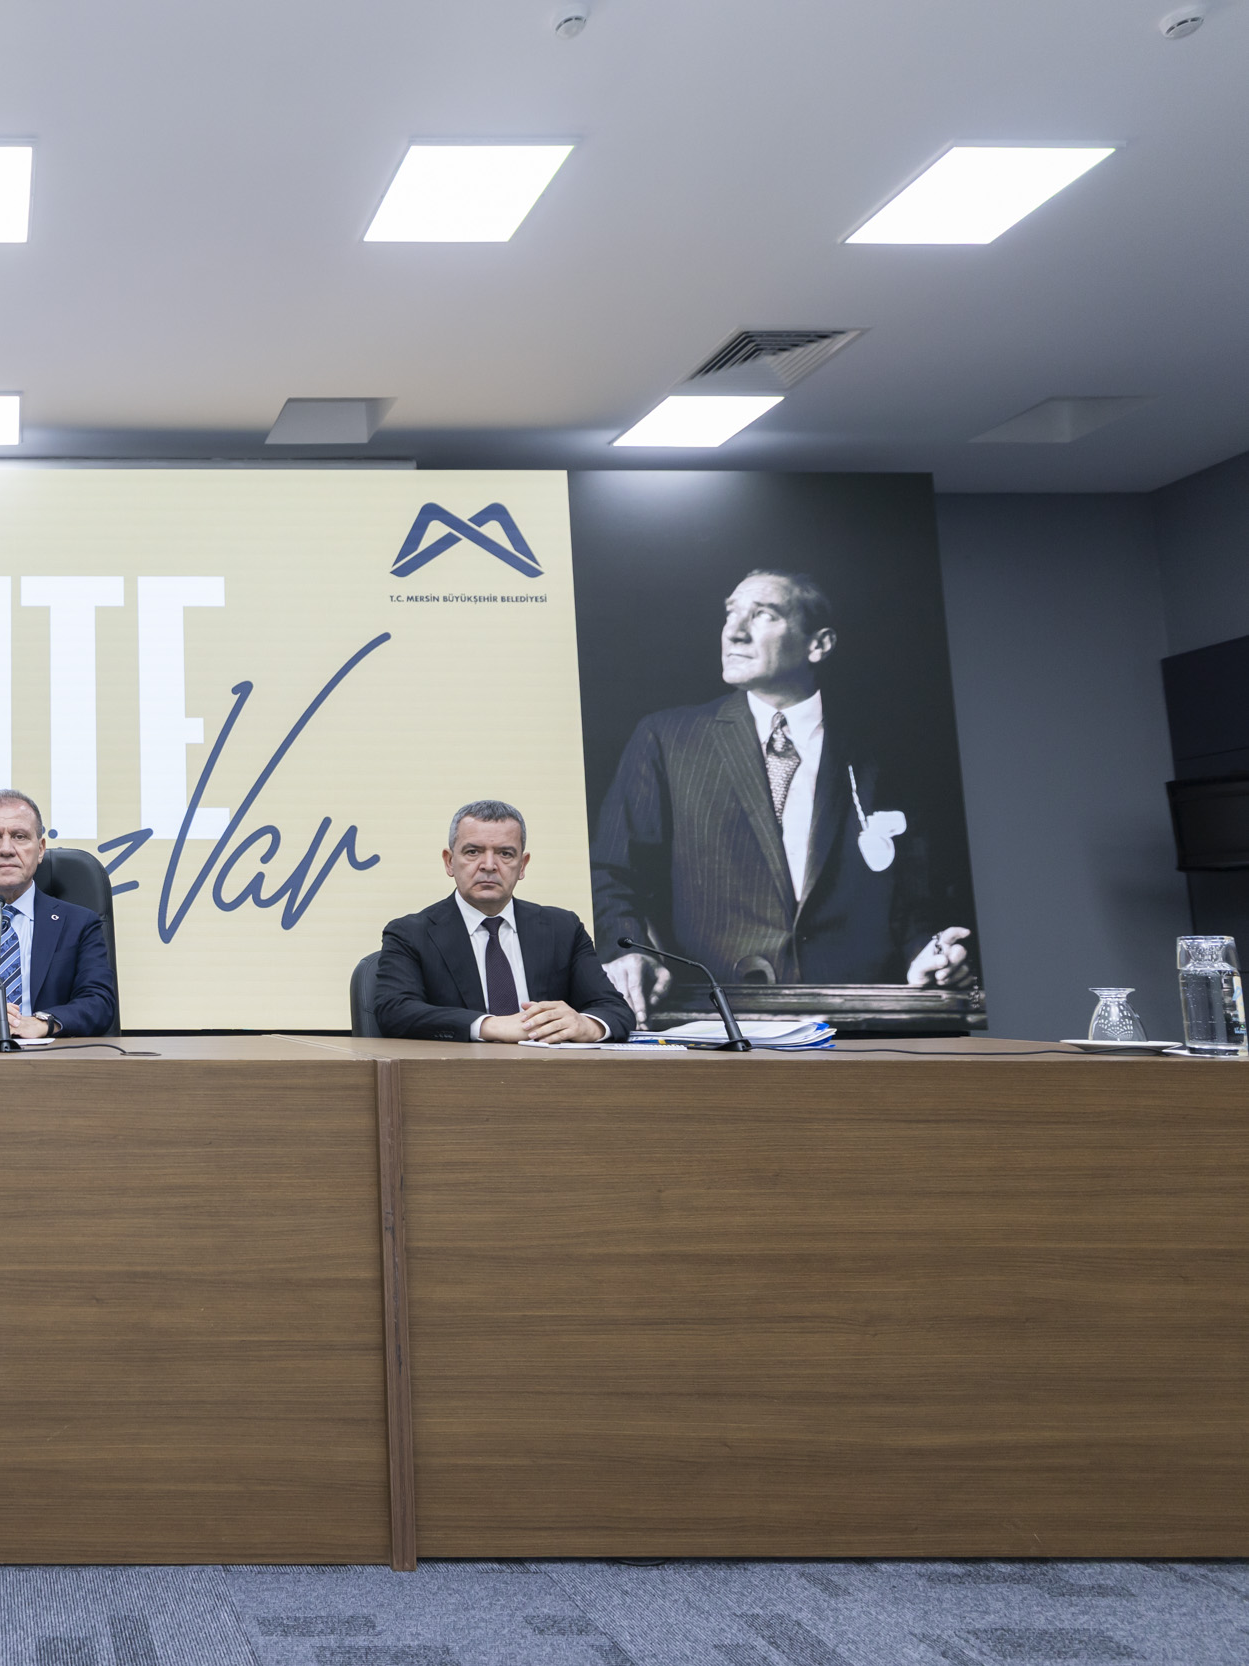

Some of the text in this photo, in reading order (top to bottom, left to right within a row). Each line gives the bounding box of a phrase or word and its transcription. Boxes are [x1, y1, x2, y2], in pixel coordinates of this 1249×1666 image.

[389, 593, 548, 605] T.C. MERSİN BÜYÜKŞEHİR BELEDİYESİ
[157, 632, 392, 944] Var
